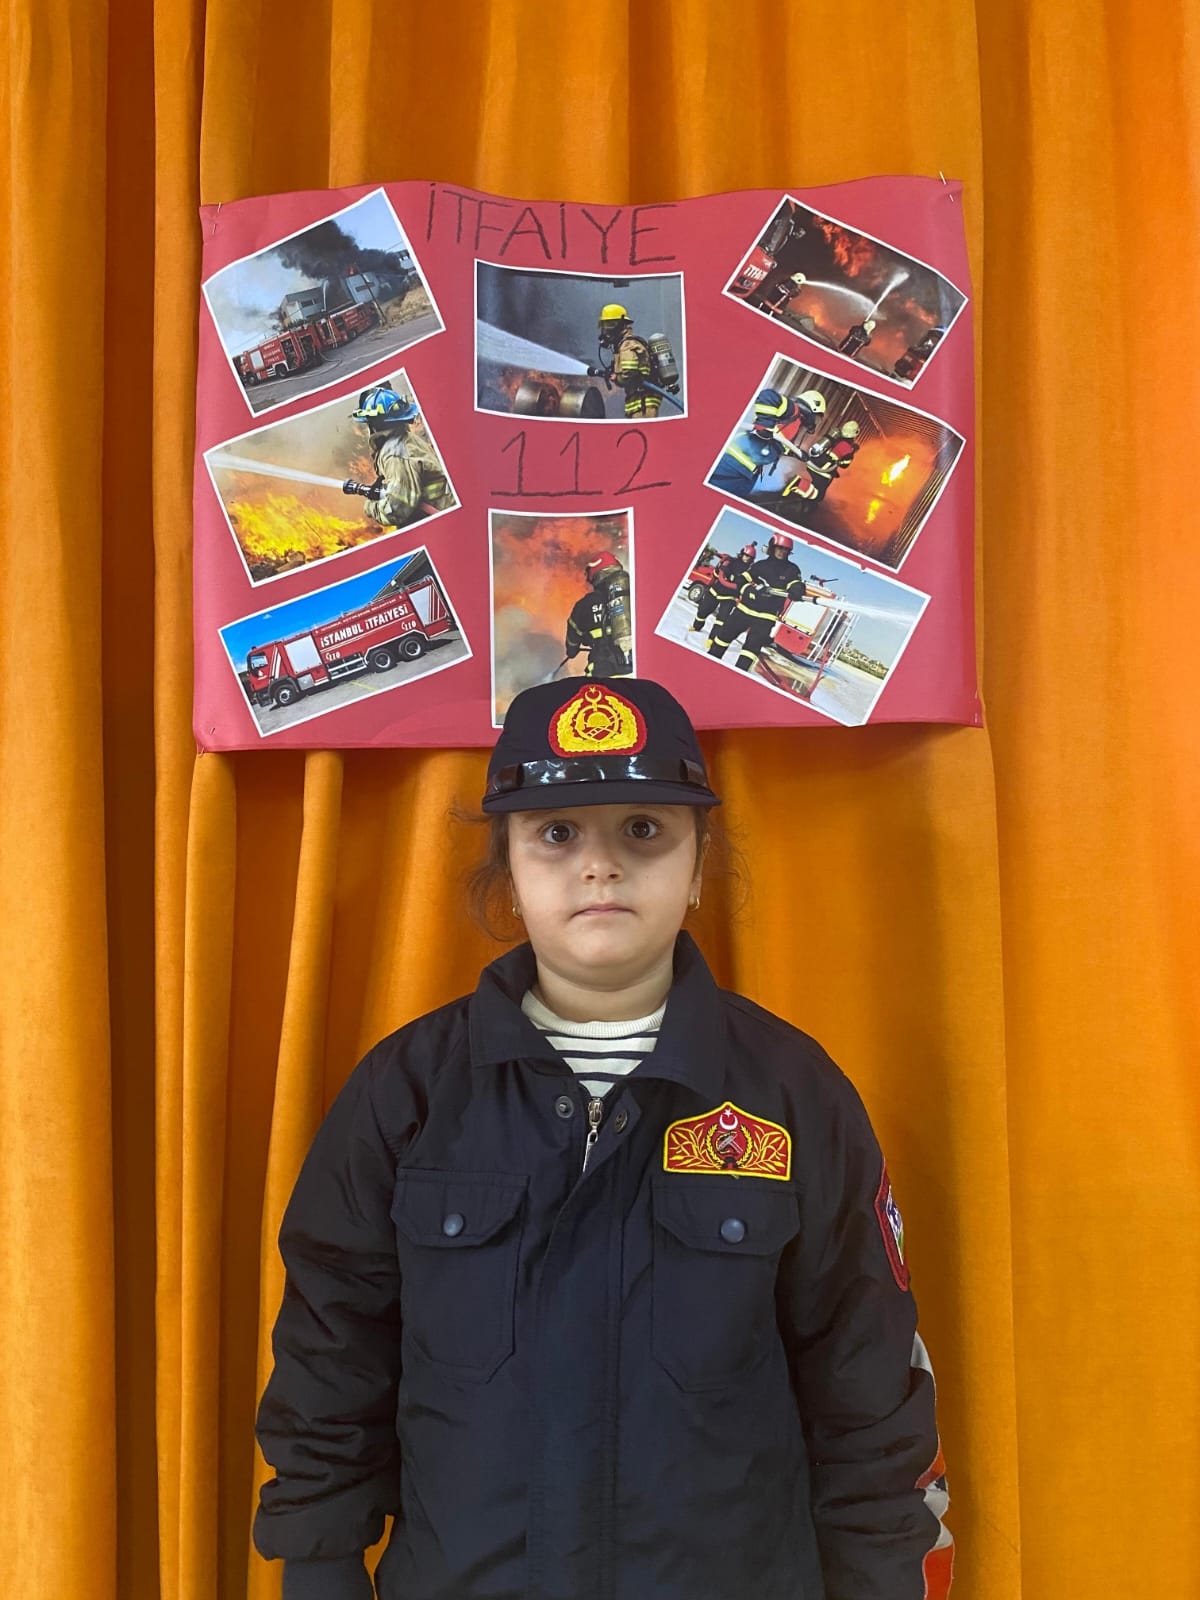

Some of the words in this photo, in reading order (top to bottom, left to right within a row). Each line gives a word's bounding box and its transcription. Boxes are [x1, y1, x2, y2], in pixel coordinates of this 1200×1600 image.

[427, 183, 677, 266] İTFAİYE
[490, 429, 672, 497] 112
[320, 623, 363, 648] İSTANBUL
